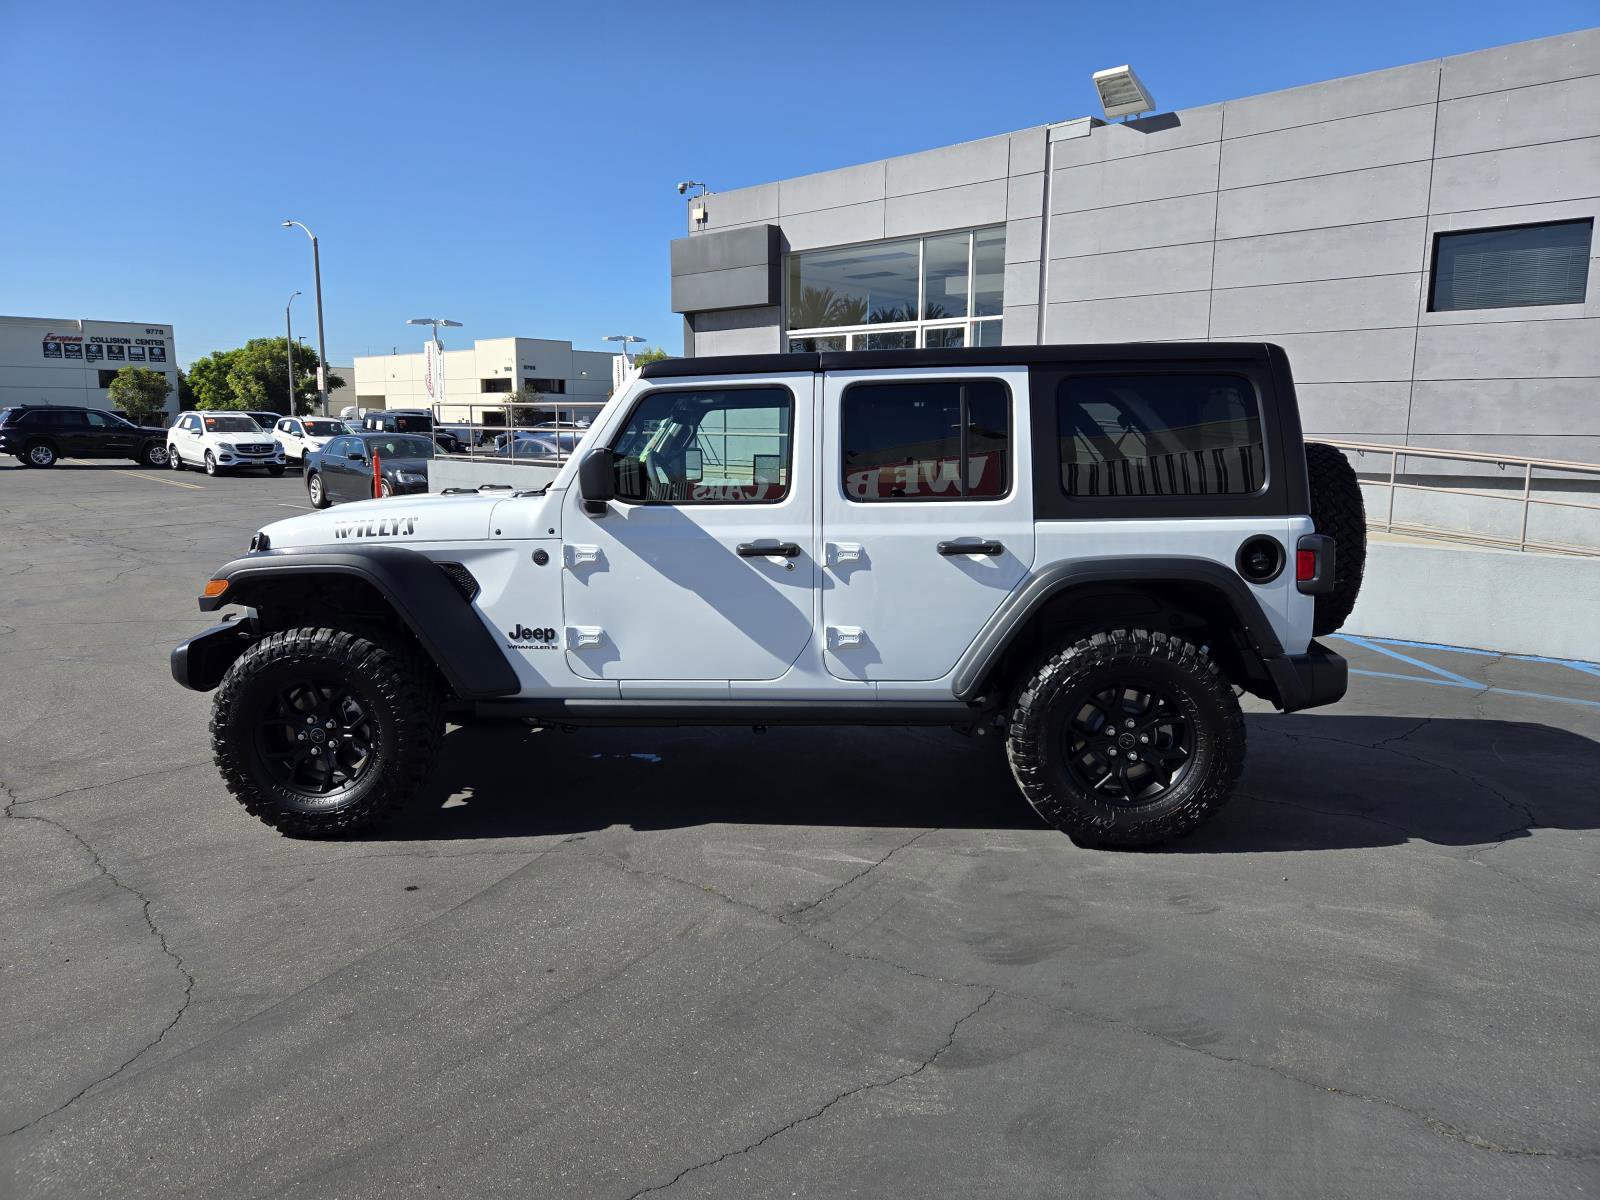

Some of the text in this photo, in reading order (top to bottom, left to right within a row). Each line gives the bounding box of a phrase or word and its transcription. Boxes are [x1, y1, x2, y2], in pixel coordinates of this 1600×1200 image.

[90, 336, 131, 345] COLLISION
[335, 516, 418, 538] WILLYS
[508, 624, 556, 643] Jeep
